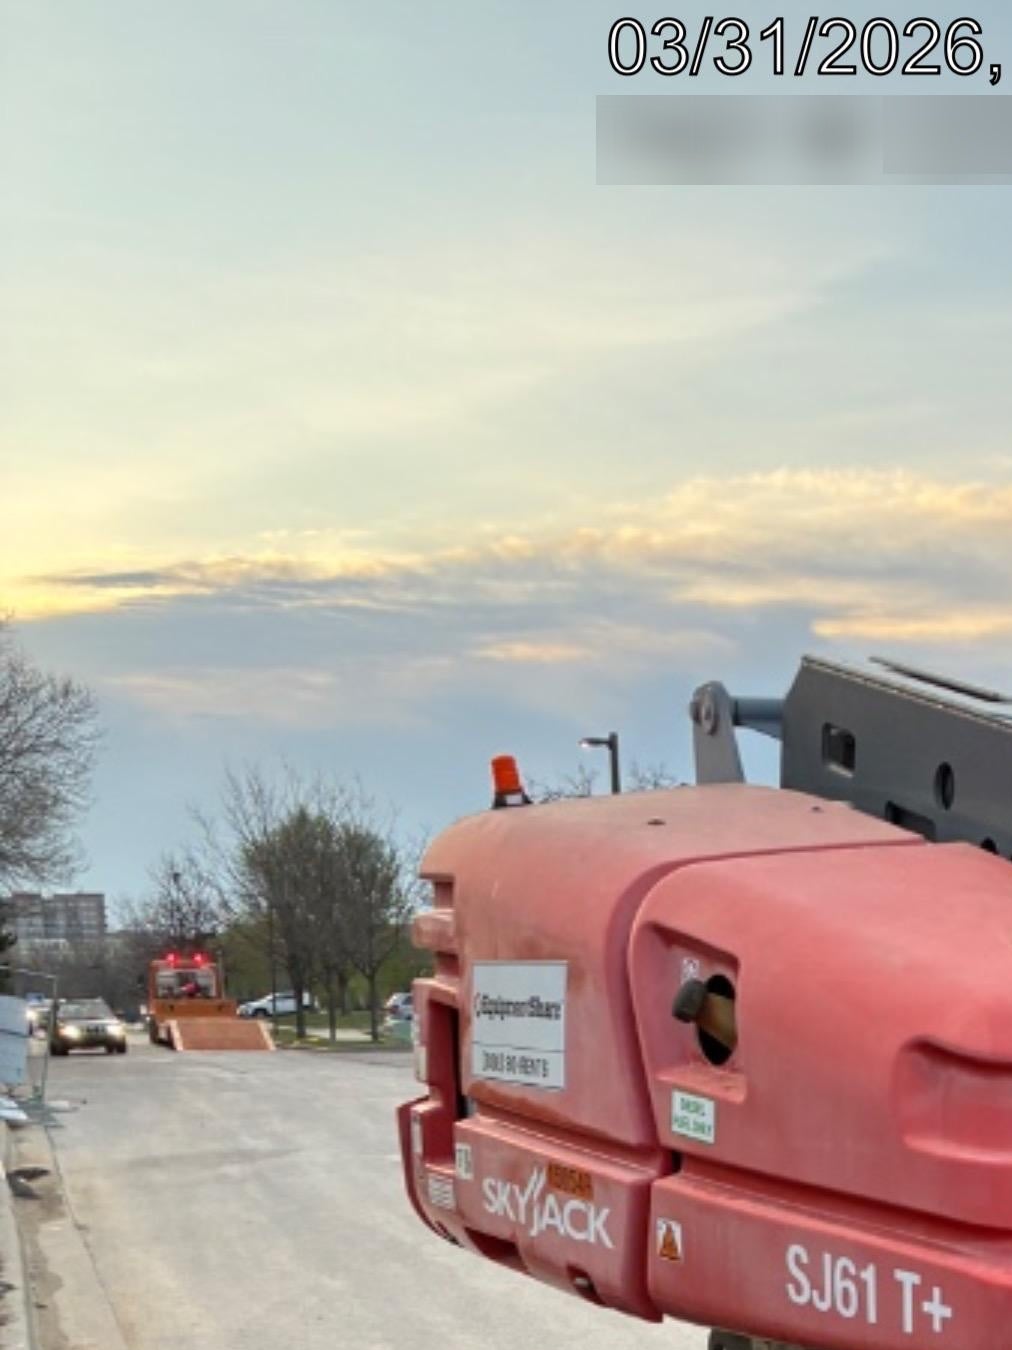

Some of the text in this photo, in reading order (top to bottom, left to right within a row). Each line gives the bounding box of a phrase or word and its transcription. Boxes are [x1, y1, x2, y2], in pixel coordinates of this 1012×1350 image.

[482, 1167, 616, 1249] SKYJACK
[786, 1244, 953, 1335] SJ61 T+
